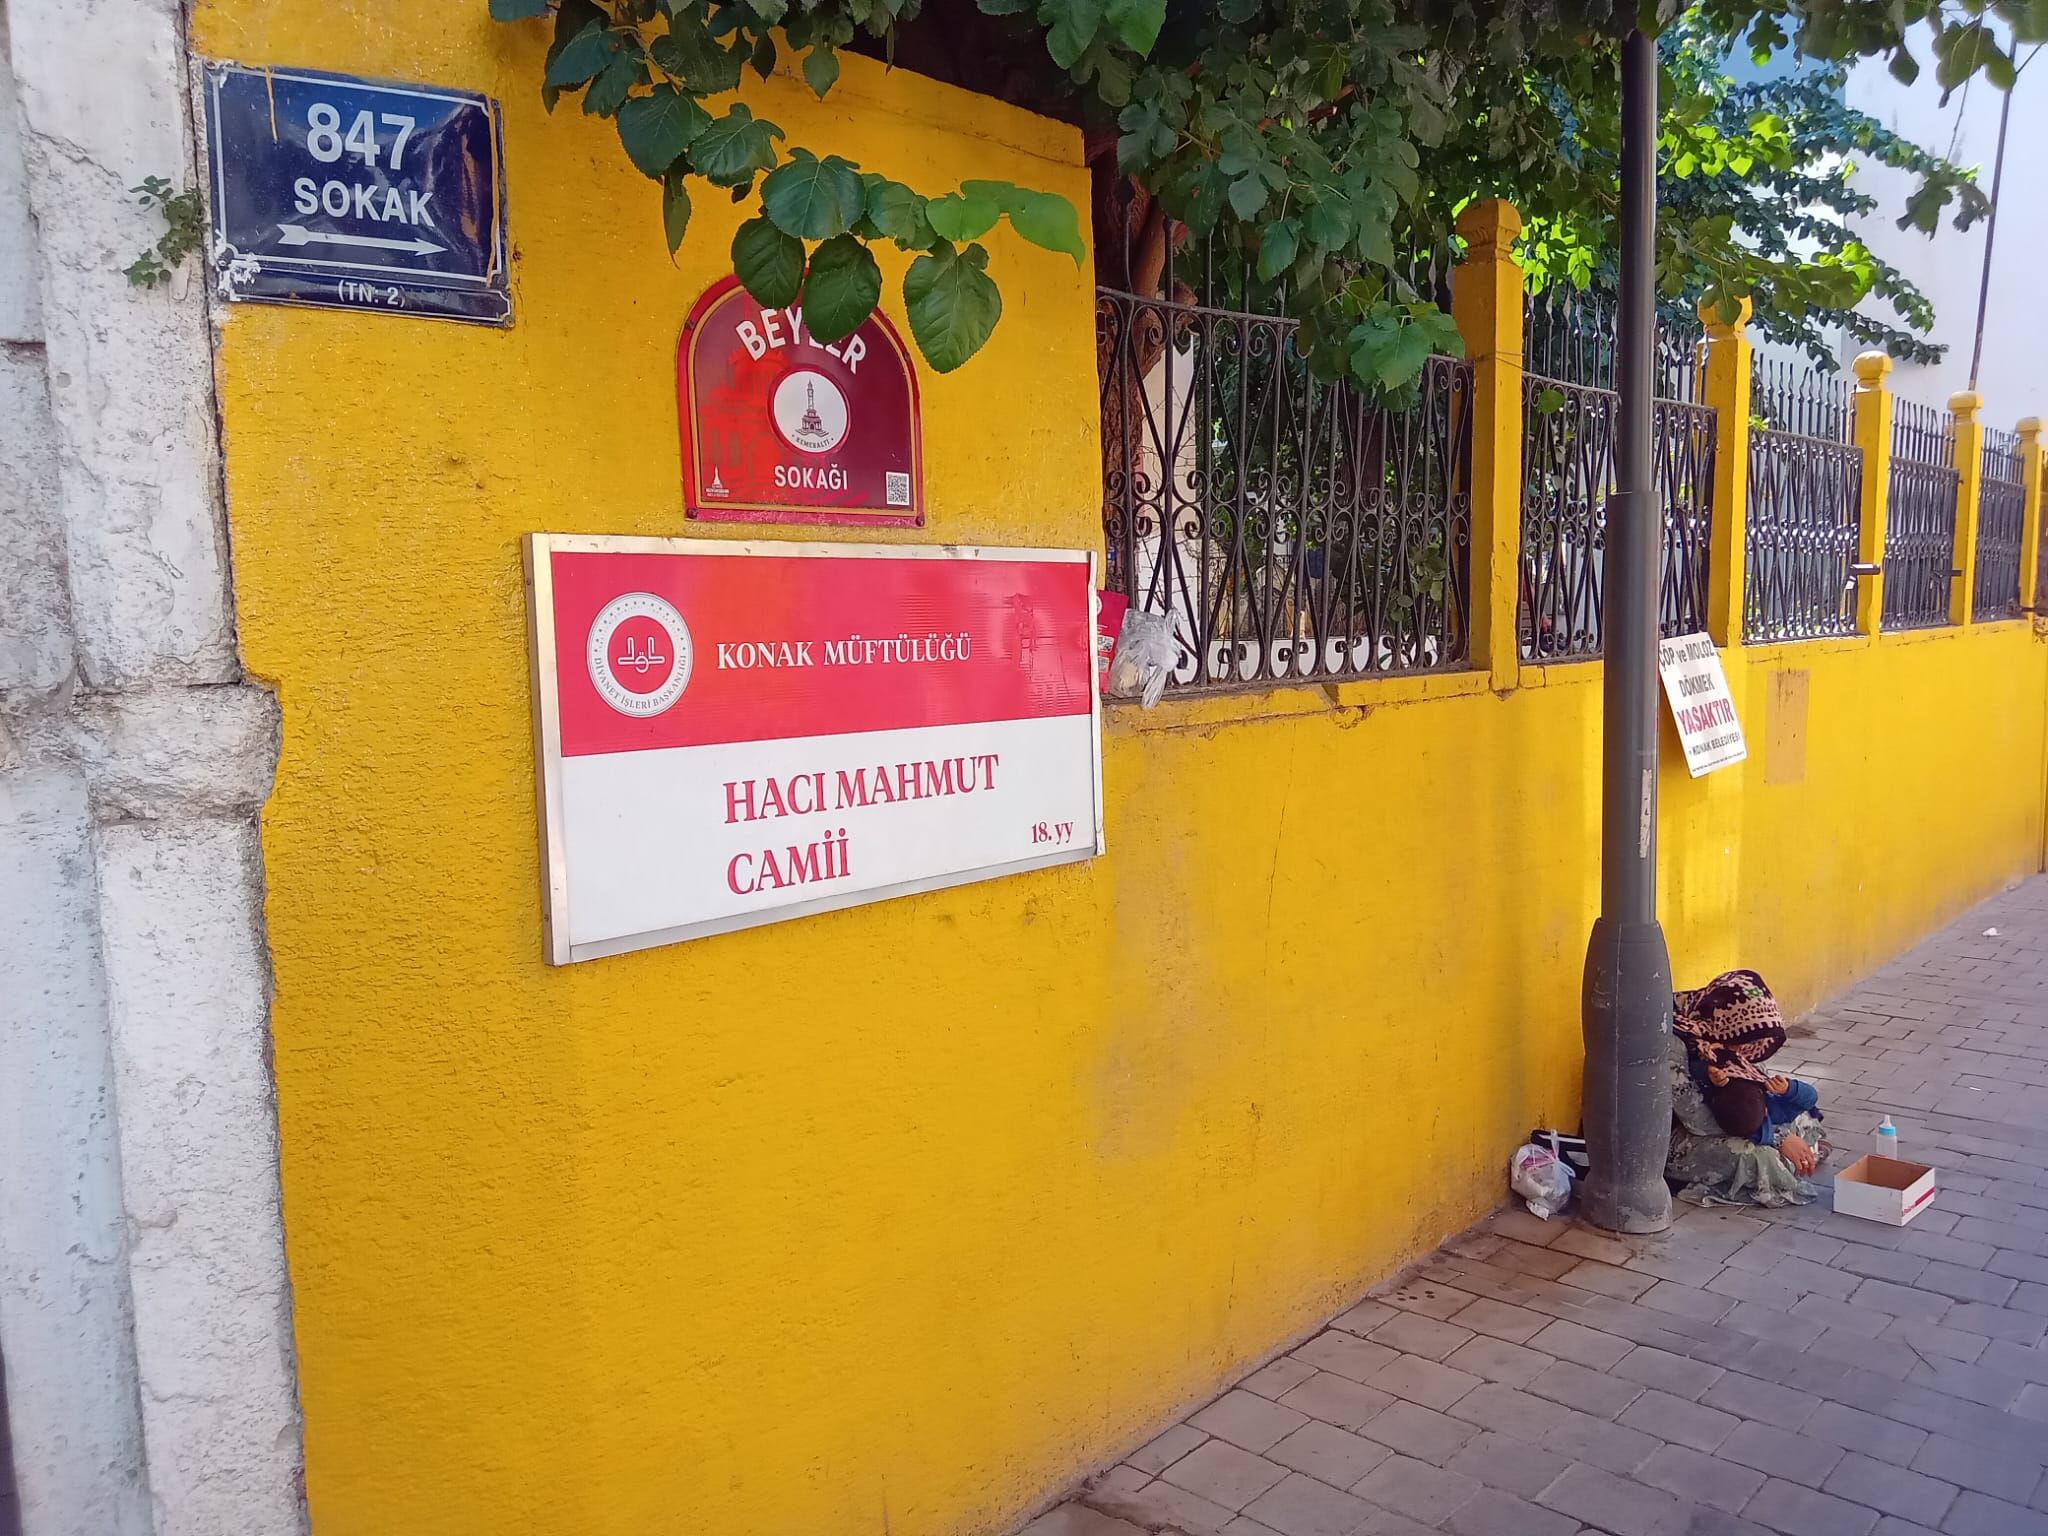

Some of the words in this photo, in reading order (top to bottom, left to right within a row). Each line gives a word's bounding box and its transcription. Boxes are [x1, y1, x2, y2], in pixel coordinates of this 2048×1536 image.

[307, 103, 415, 170] 847
[294, 177, 435, 227] SOKAK
[338, 279, 379, 303] (TN:
[387, 285, 405, 308] 2)
[774, 464, 848, 490] SOKAĞI
[717, 641, 814, 669] KONAK
[824, 632, 972, 665] MÜFTÜLÜĞÜ
[1658, 644, 1675, 671] ÇÖP
[1676, 649, 1687, 663] ve
[1685, 639, 1715, 661] MOLOZ
[1678, 672, 1715, 698] DÖKMEK
[1676, 698, 1735, 736] YASAKTIR
[723, 772, 827, 824] HACI
[834, 754, 999, 810] MAHMUT
[727, 828, 850, 895] CAMİİ
